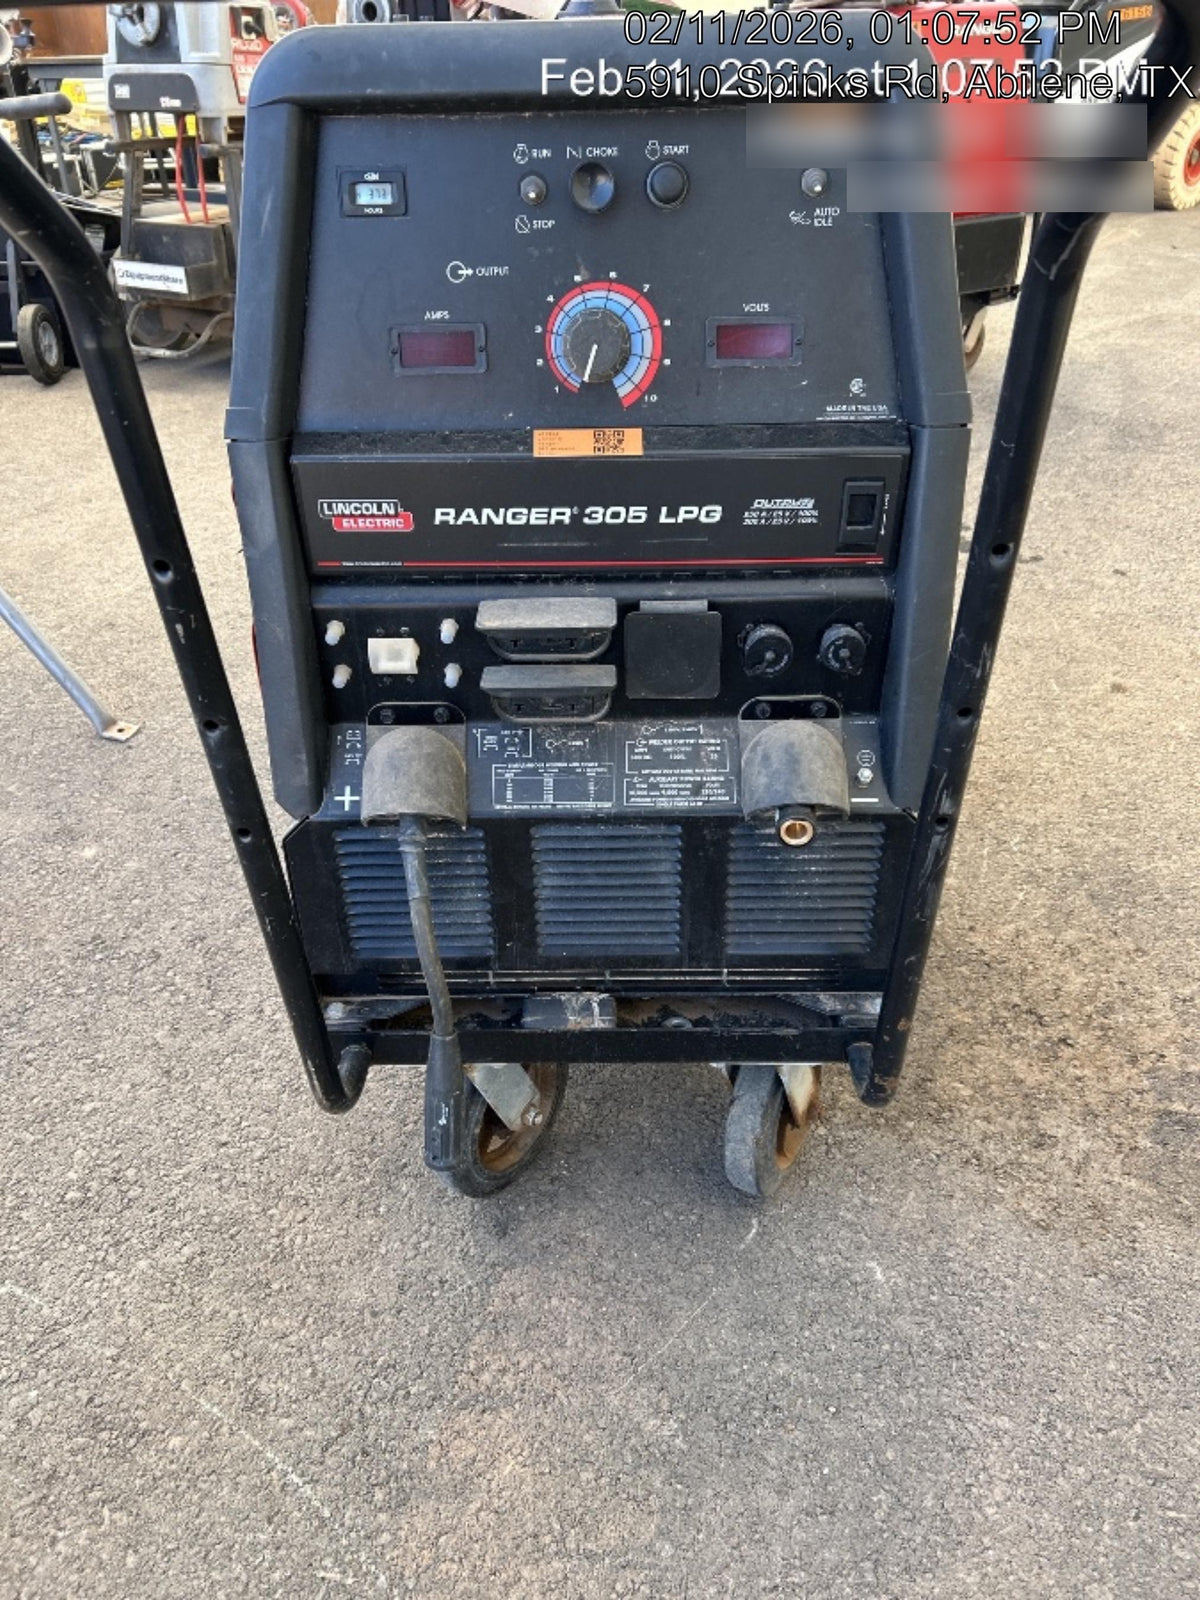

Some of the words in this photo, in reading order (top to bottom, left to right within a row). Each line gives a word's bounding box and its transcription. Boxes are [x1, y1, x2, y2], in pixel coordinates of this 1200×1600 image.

[531, 148, 552, 159] RUN
[586, 146, 618, 158] CHOKE
[662, 144, 690, 156] START
[814, 207, 840, 216] AUTO
[532, 219, 555, 230] STOP
[475, 265, 509, 277] OUTPUT
[642, 284, 651, 293] 7
[546, 294, 555, 304] 4
[742, 302, 770, 313] VOLTS
[424, 310, 450, 321] AMPS
[553, 384, 560, 394] 1
[644, 393, 659, 403] 10
[322, 502, 396, 516] LINCOLN
[582, 506, 648, 525] 305
[658, 504, 723, 524] LPG
[341, 517, 405, 529] ELECTRIC
